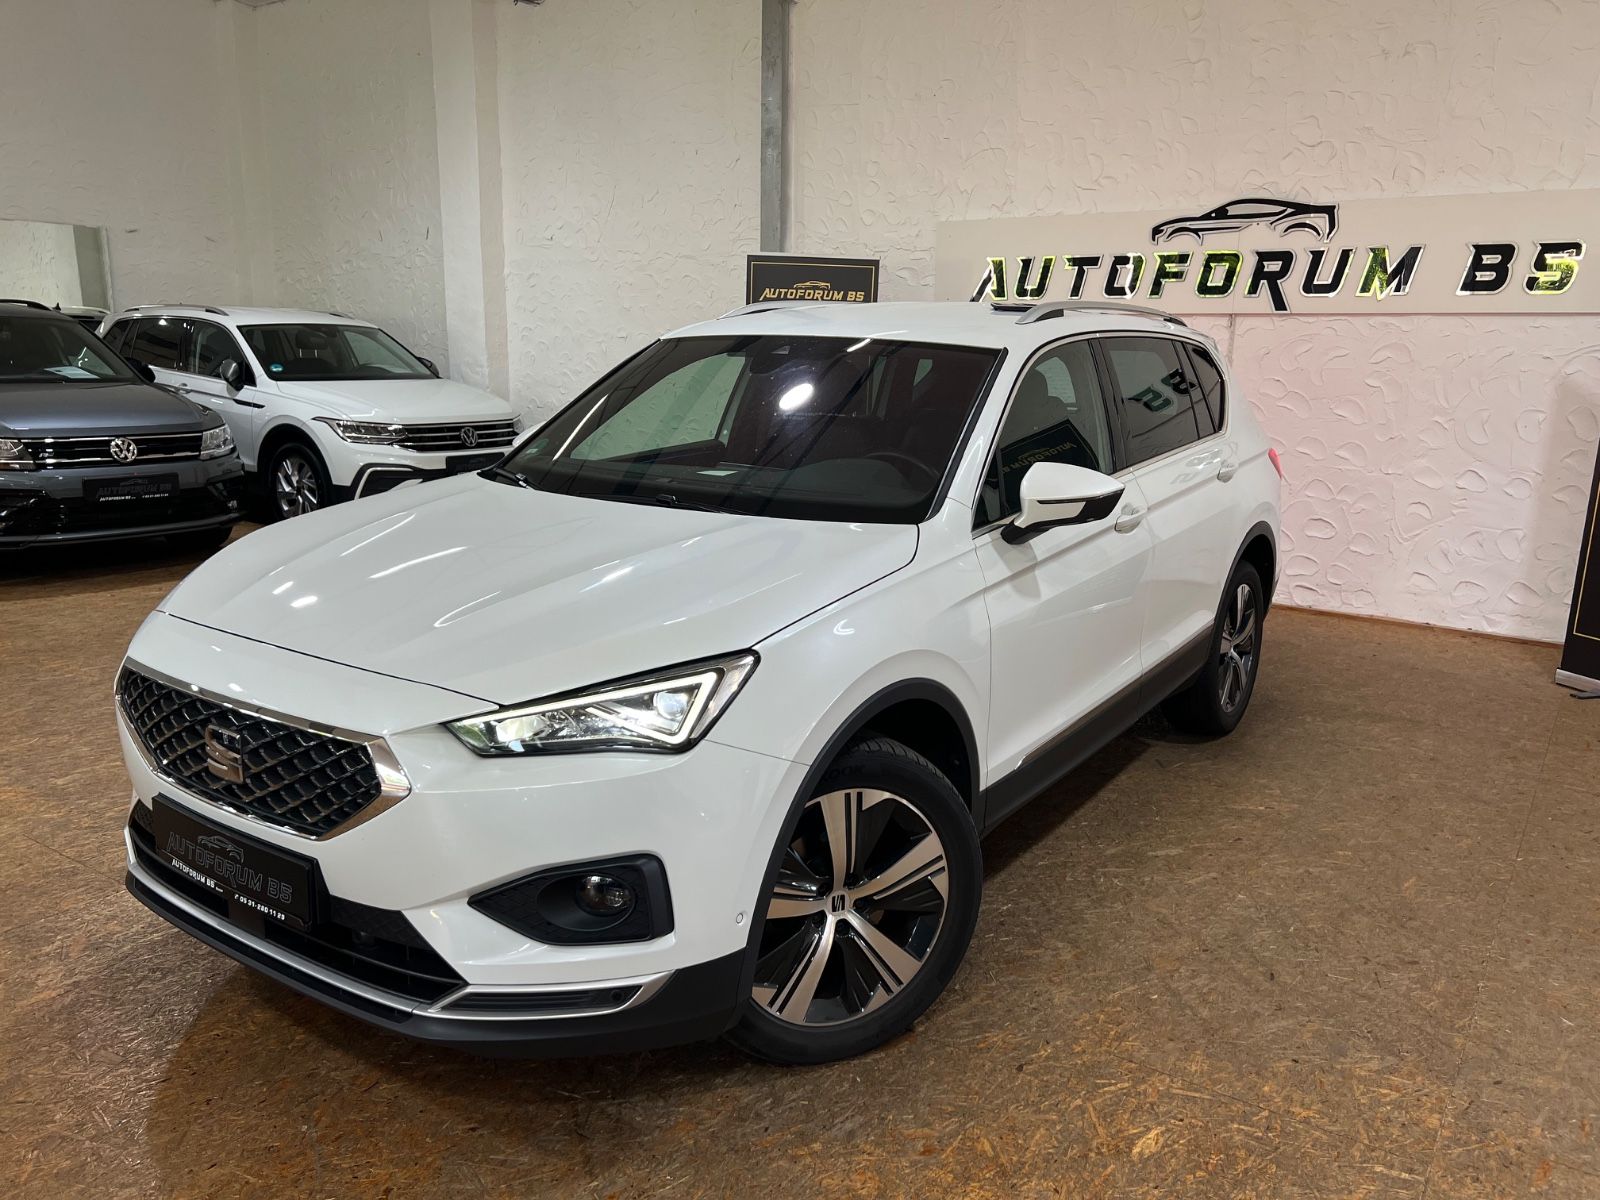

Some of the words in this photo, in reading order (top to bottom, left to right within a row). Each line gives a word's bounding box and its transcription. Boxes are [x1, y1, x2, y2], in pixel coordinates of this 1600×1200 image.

[759, 288, 844, 301] AUTOFORUM
[969, 244, 1425, 313] AUTOFORUM
[166, 831, 264, 892] AUTOFORUM
[171, 858, 206, 884] AUTOFORUM
